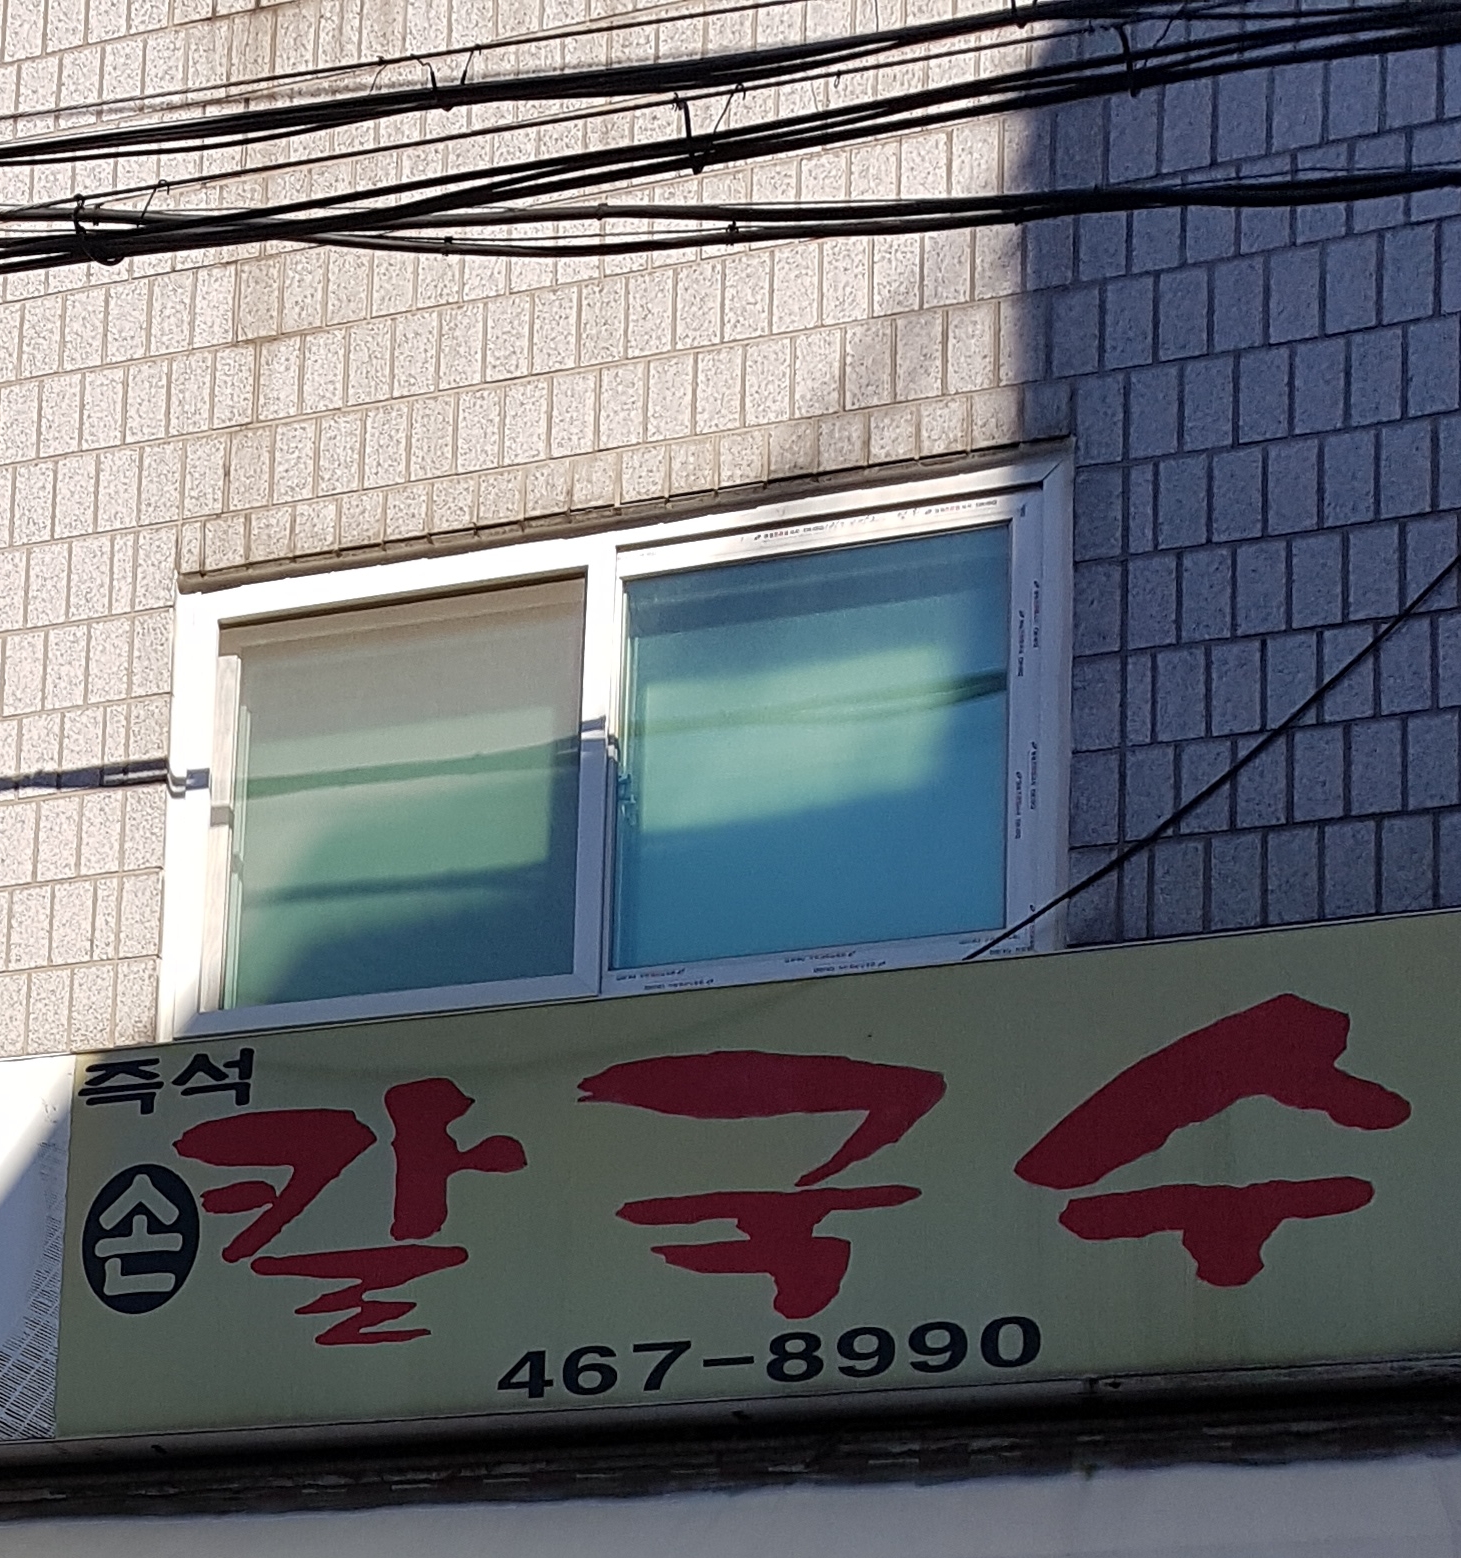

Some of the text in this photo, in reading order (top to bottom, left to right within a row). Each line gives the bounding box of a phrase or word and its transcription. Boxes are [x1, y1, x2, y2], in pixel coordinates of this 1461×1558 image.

[78, 1047, 255, 1115] 즉석
[87, 993, 1412, 1346] 손 칼국수
[497, 1315, 1043, 1399] 467-8990
